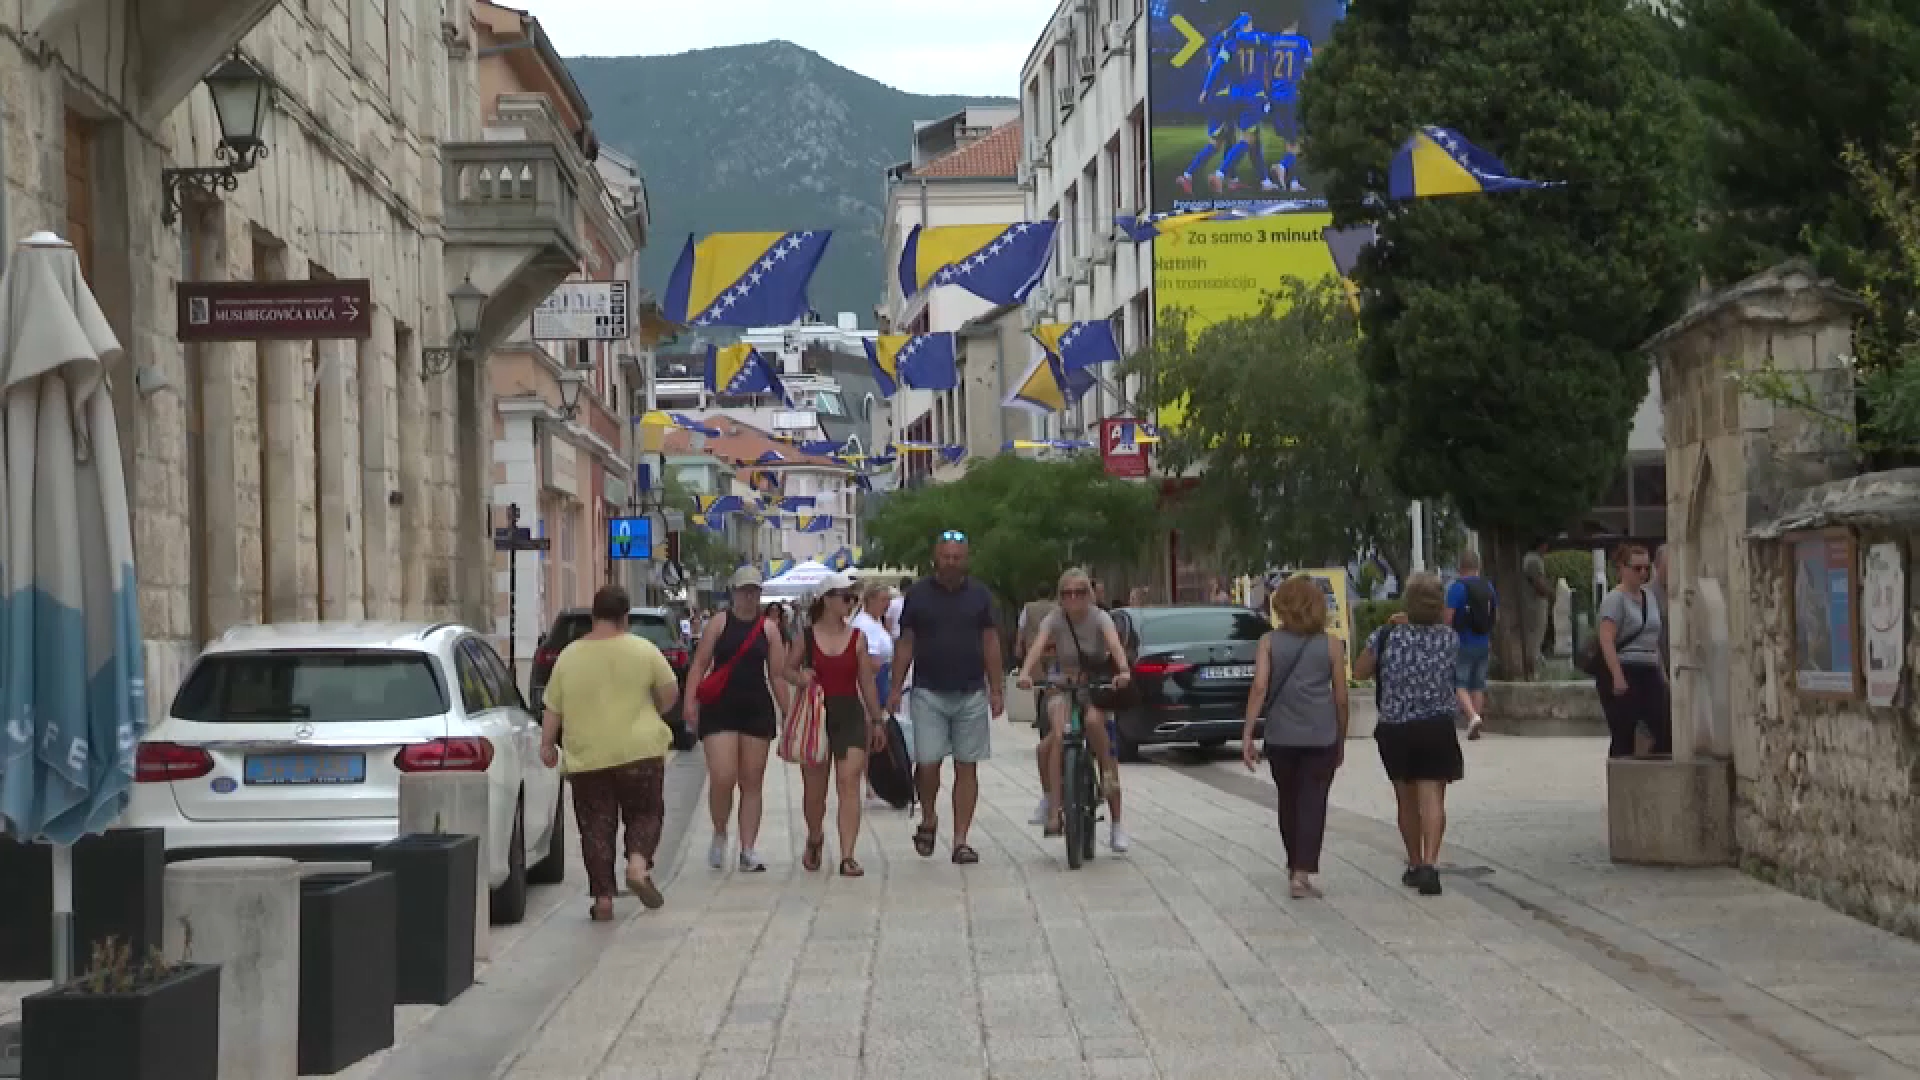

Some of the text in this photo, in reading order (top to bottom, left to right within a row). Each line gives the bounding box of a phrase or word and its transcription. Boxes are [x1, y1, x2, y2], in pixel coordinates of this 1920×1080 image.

[1238, 48, 1255, 76] 11
[1273, 51, 1294, 79] 21
[1188, 230, 1207, 245] Za
[1211, 231, 1253, 244] samo
[1257, 229, 1267, 243] 3
[1155, 256, 1207, 271] latnih
